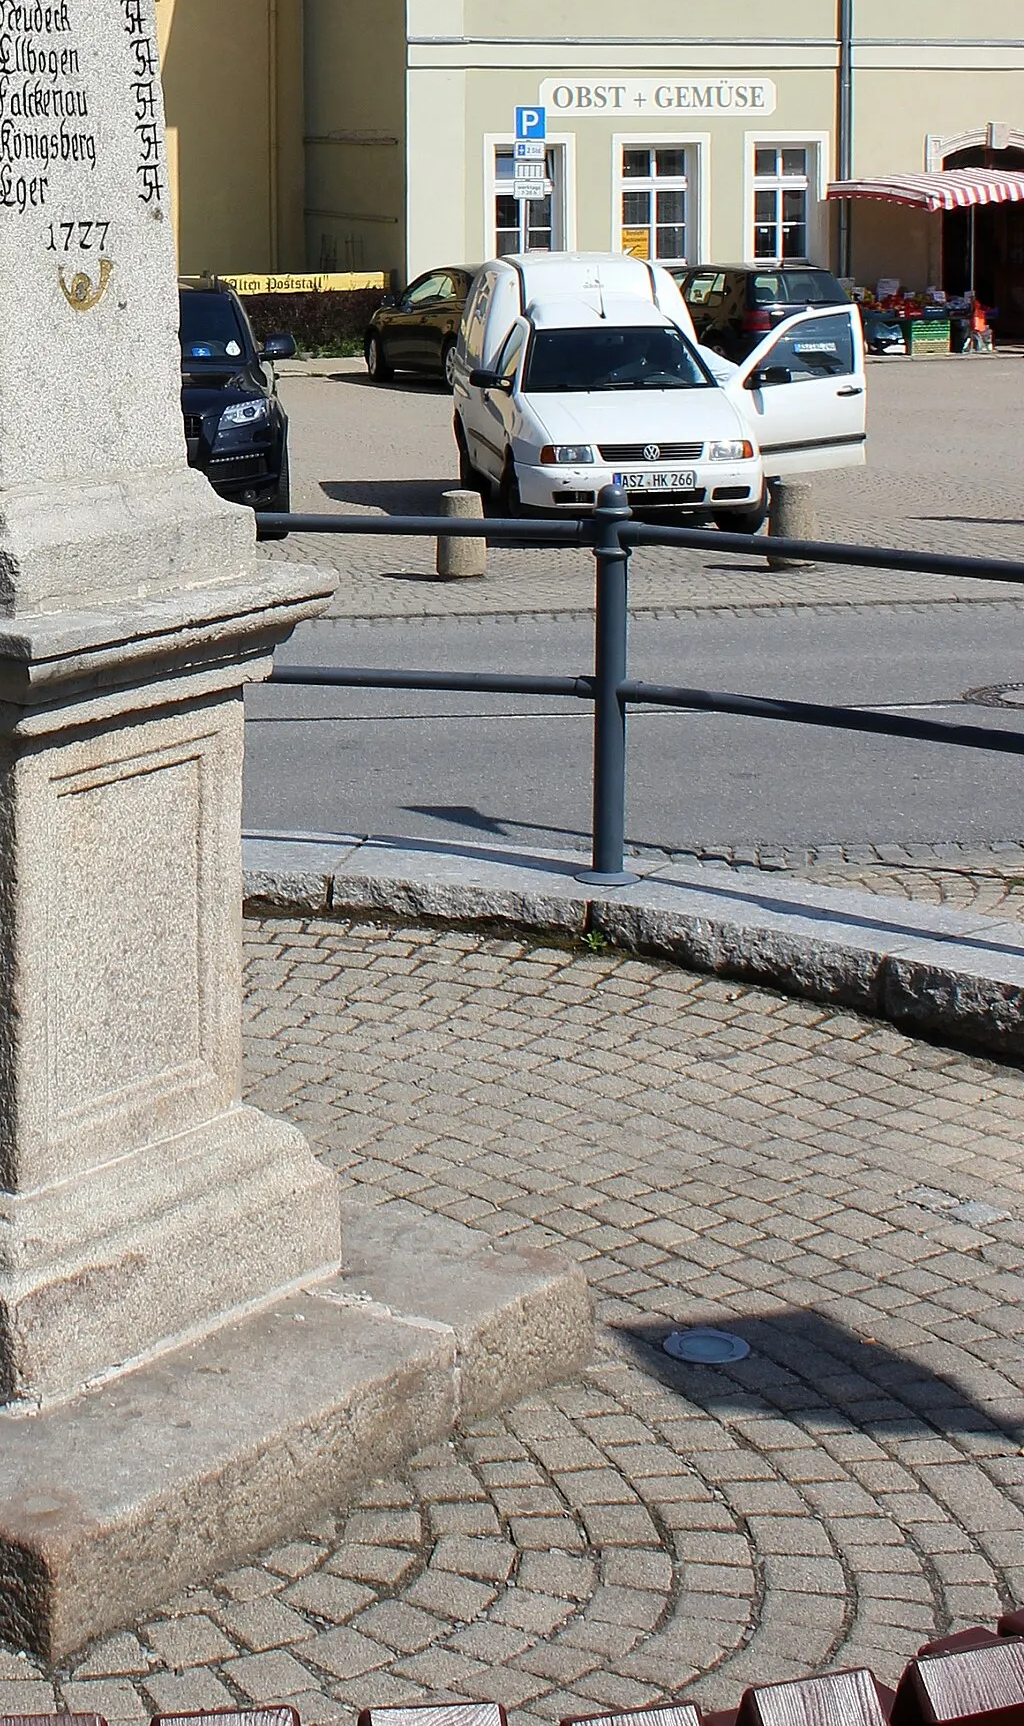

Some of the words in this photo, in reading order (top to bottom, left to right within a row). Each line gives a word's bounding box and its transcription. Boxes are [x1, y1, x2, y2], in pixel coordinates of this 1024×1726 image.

[552, 85, 626, 108] OBST
[633, 92, 647, 108] +
[653, 80, 765, 108] GEMÜSE
[46, 221, 111, 251] 1727
[622, 475, 644, 488] ASZ
[652, 474, 667, 487] HK
[670, 474, 693, 486] 266
